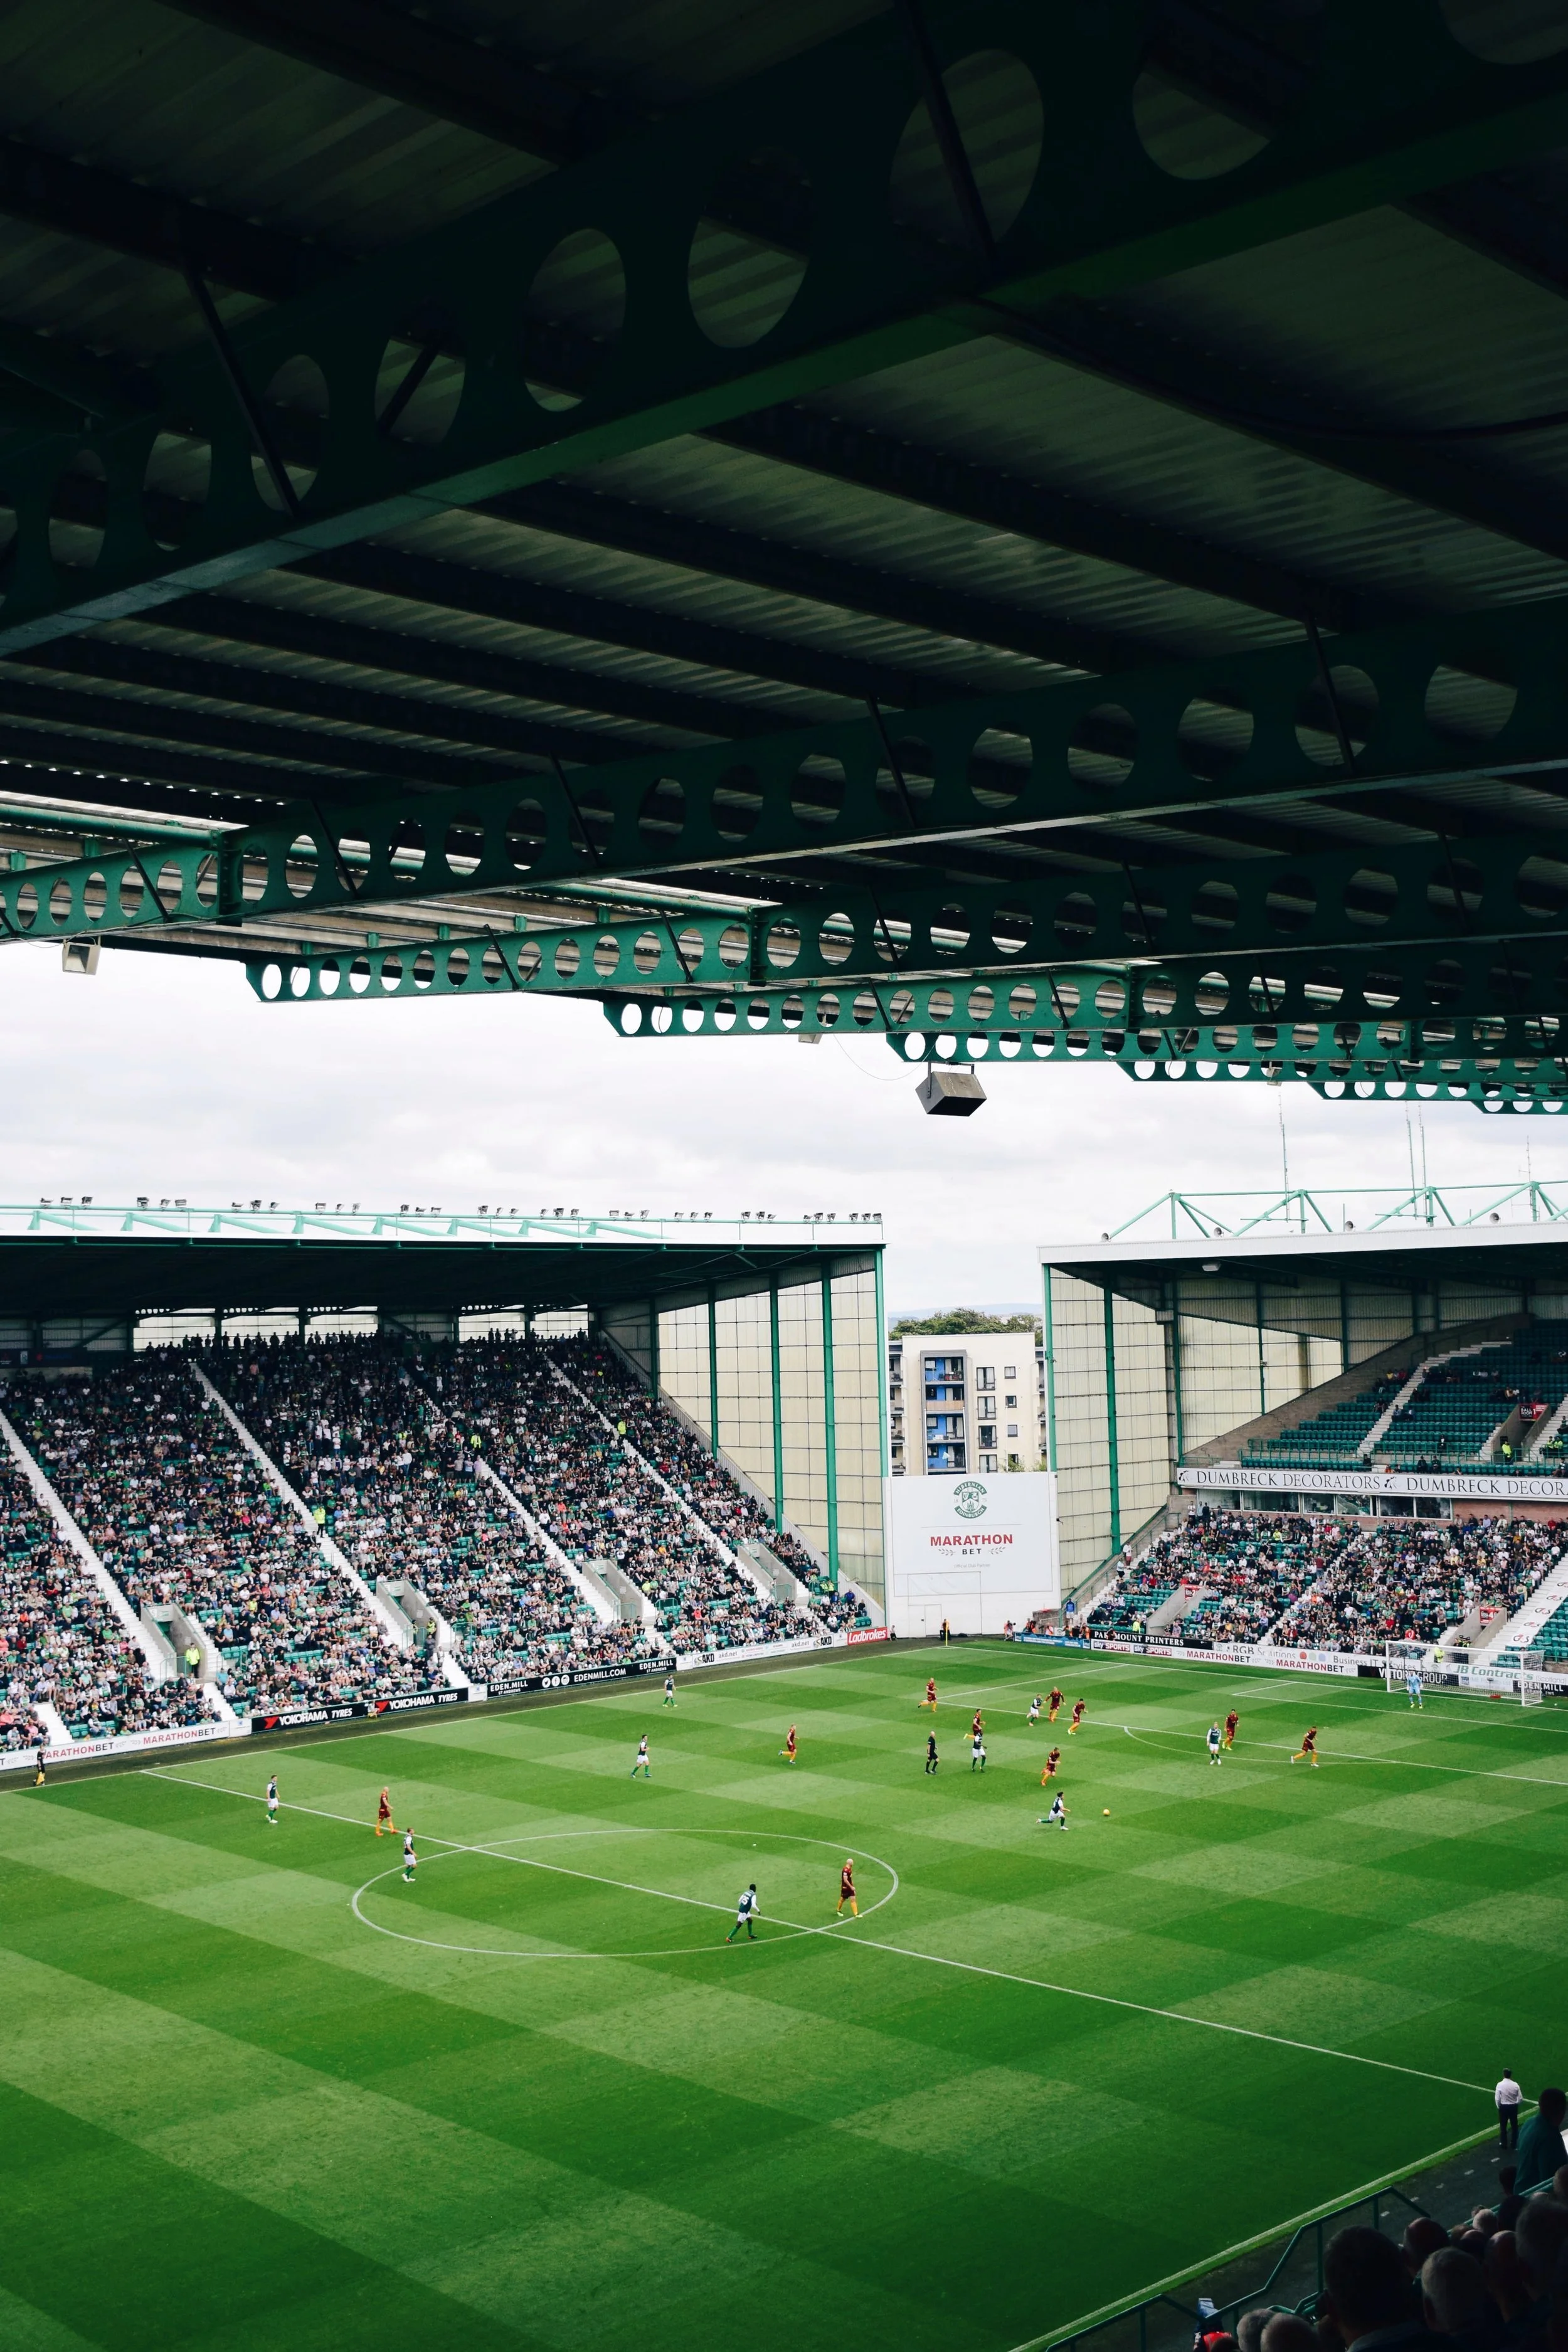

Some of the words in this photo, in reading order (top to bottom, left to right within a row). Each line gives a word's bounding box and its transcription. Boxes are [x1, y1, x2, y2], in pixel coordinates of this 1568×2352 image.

[955, 1481, 986, 1494] HIBERNIAN
[1197, 1471, 1277, 1486] DUMBRECK
[1283, 1473, 1380, 1489] DECORATORS
[1407, 1477, 1501, 1493] DUMBRECK
[1507, 1480, 1568, 1495] DECOR
[956, 1507, 985, 1518] EDINBURGH
[930, 1534, 1014, 1546] MARATHON
[820, 1636, 832, 1646] AKD
[849, 1629, 886, 1643] Ladbrokes
[1145, 1636, 1184, 1646] PRINTERS
[1093, 1641, 1104, 1649] sky
[1106, 1642, 1130, 1651] SPORTS
[1134, 1645, 1144, 1653] sky
[1146, 1647, 1171, 1655] SPORTS
[1233, 1645, 1254, 1655] RGB
[702, 1653, 715, 1663] AKD
[1187, 1651, 1251, 1663] MARATHONBET
[1333, 1655, 1367, 1666] Business
[640, 1660, 673, 1670] EDEN.MILL
[1276, 1660, 1344, 1673] MARATHONBET
[1453, 1665, 1469, 1673] JB
[574, 1668, 627, 1682] EDENMILL.COM
[490, 1680, 528, 1692] EDEN.MILL
[389, 1695, 435, 1710] YOKOHAMA
[438, 1693, 458, 1703] TYRES
[279, 1710, 328, 1725] YOKOHAMA
[331, 1708, 353, 1719] TYRES
[143, 1728, 216, 1744] MARATHONBET
